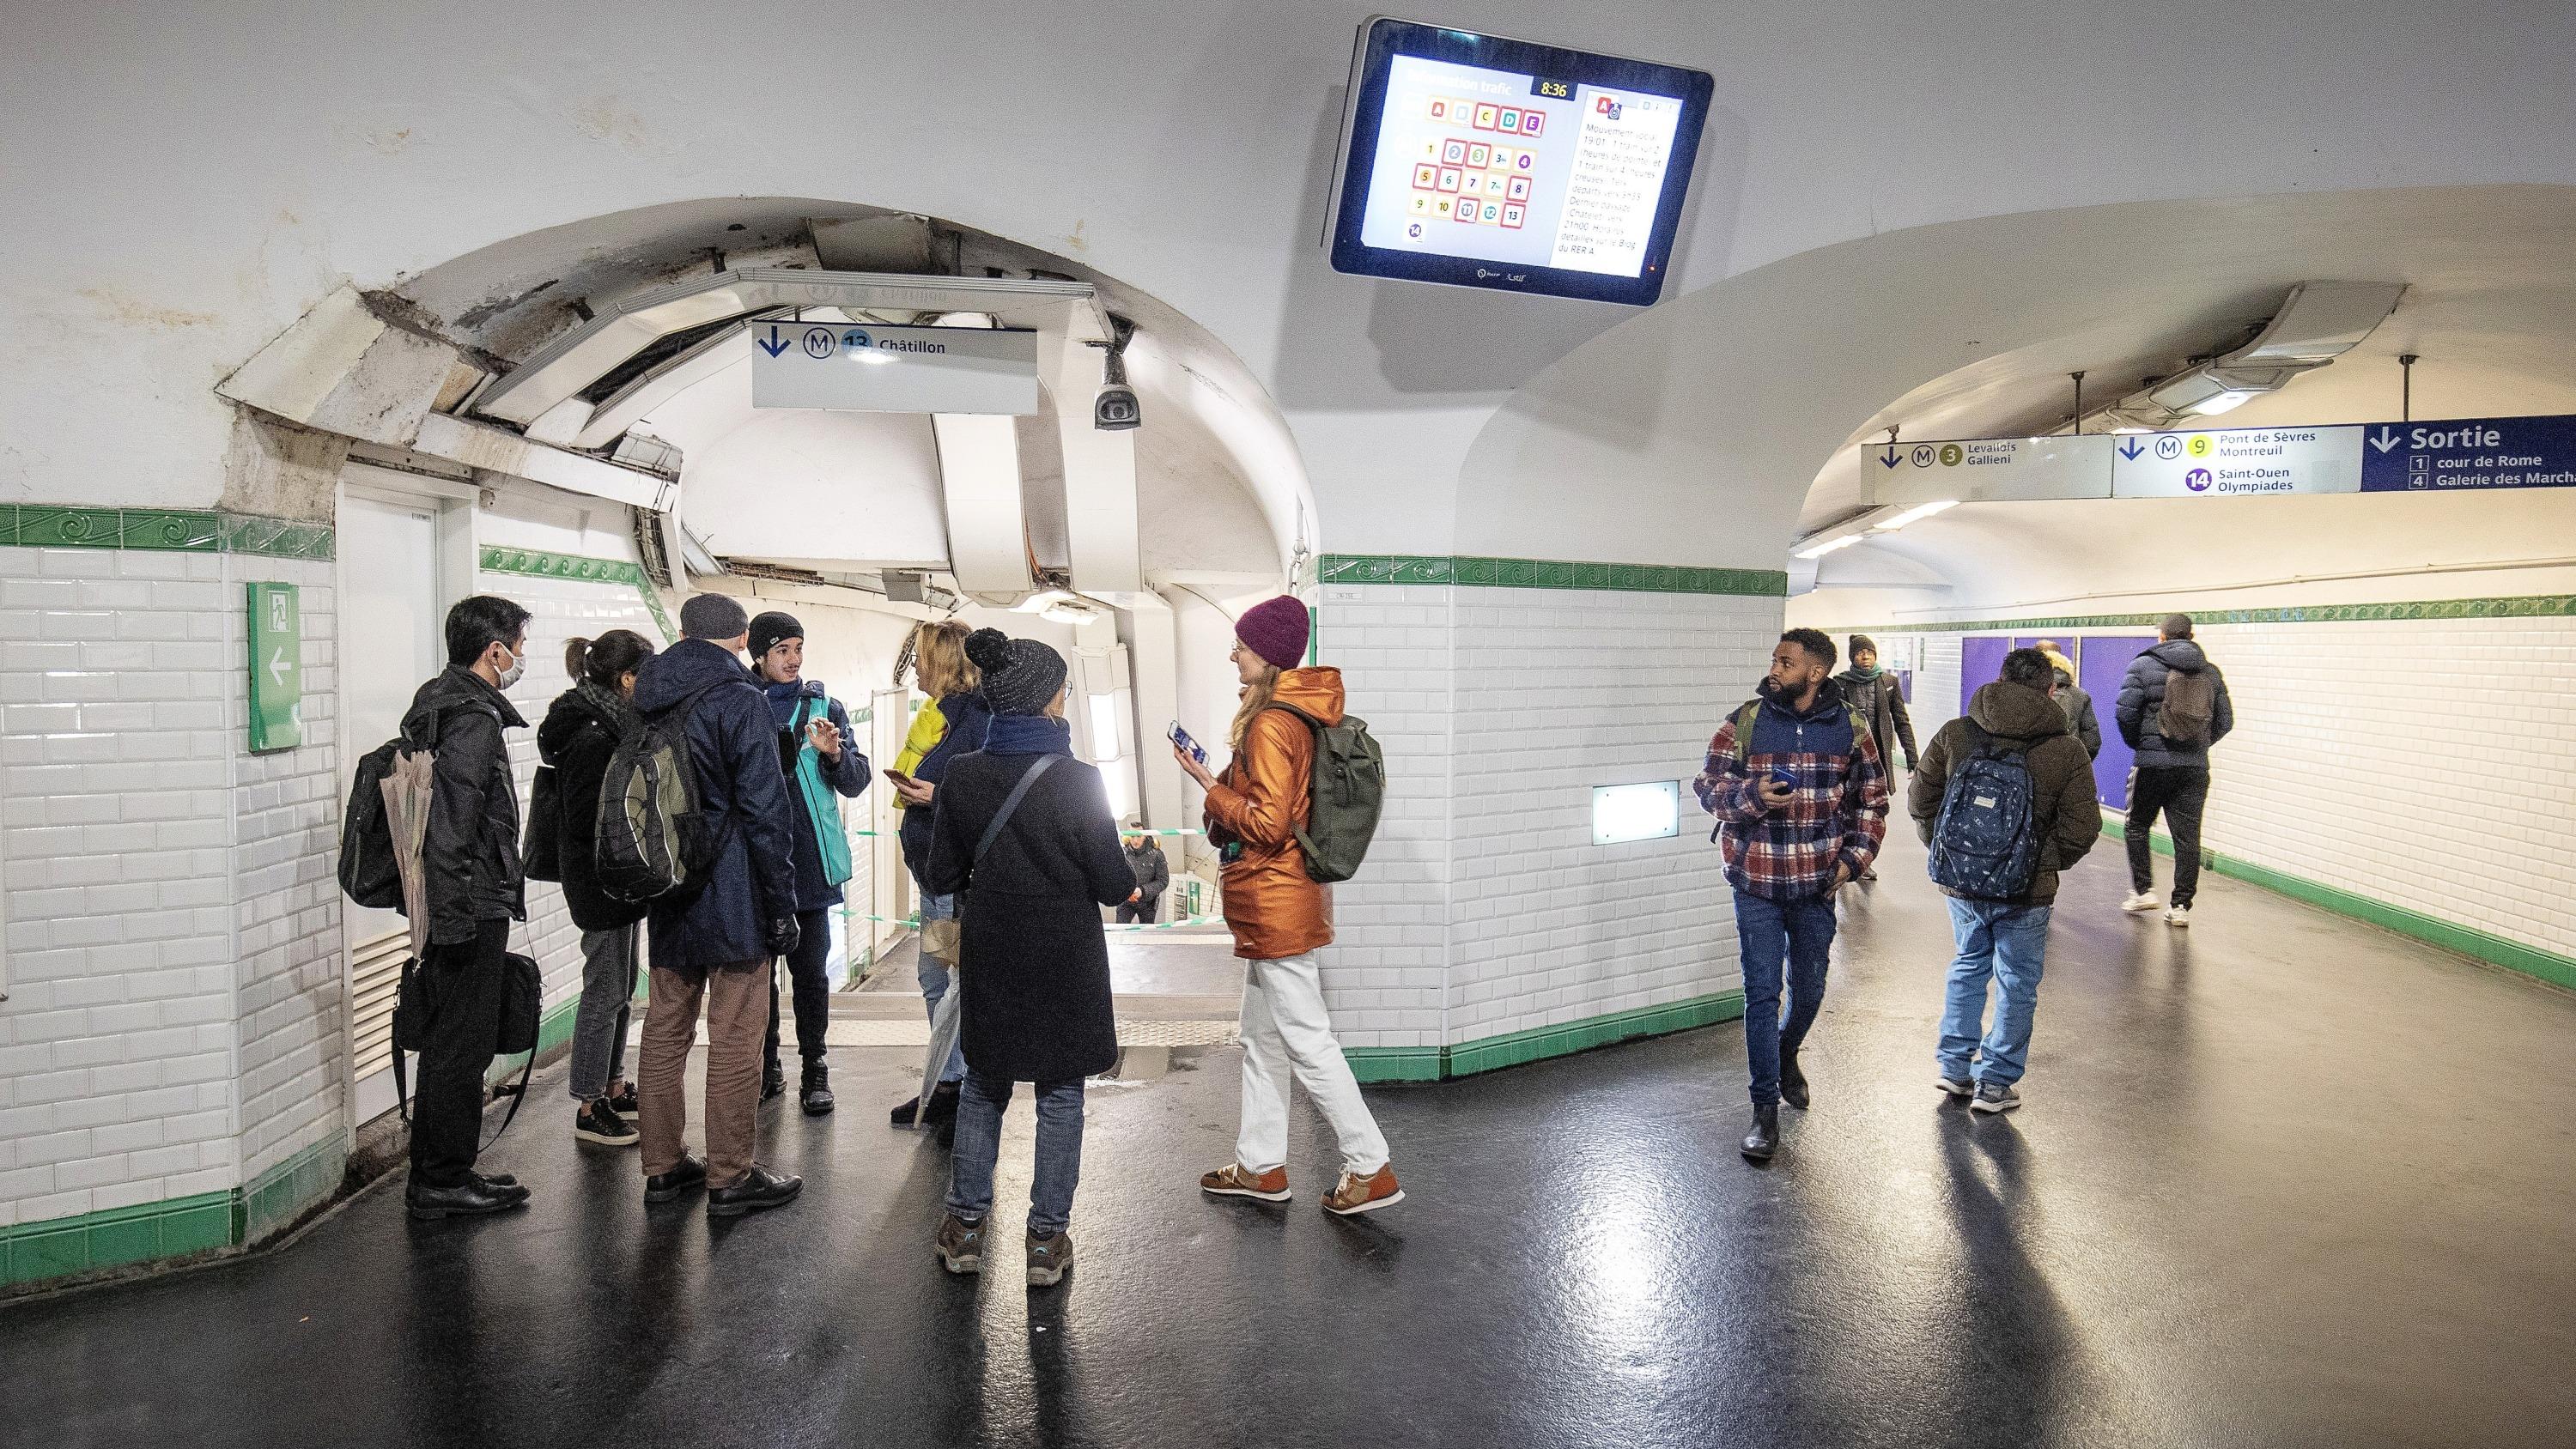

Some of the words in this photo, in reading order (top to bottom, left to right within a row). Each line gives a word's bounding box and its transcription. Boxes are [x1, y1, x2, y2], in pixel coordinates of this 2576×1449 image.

[1481, 82, 1513, 97] trafic
[1541, 82, 1568, 97] 8:36
[1428, 145, 1432, 154] 1
[1422, 173, 1429, 181] 5
[1446, 176, 1452, 185] 6
[1470, 179, 1476, 187] 7
[1516, 185, 1522, 194] 8
[1417, 199, 1424, 209] 9
[1438, 203, 1449, 212] 10
[1508, 211, 1518, 221] 13
[1409, 225, 1421, 236] 14
[879, 339, 945, 355] Châtillon
[2220, 433, 2249, 445] Pont
[2253, 432, 2269, 443] de
[2273, 432, 2316, 443] Sèvres
[2410, 425, 2500, 450] Sortie
[1968, 442, 2016, 453] Levallois
[2220, 446, 2283, 457] Montreuil
[1967, 454, 2011, 465] Gallieni
[2437, 457, 2470, 469] cour
[2475, 456, 2494, 468] de
[2498, 455, 2543, 467] Rome
[2188, 471, 2211, 489] 14
[2219, 468, 2290, 480] Saint-Ouen
[2436, 474, 2490, 487] Galerie
[2494, 473, 2521, 485] des
[2525, 470, 2576, 483] March
[2218, 480, 2293, 494] Olympiades
